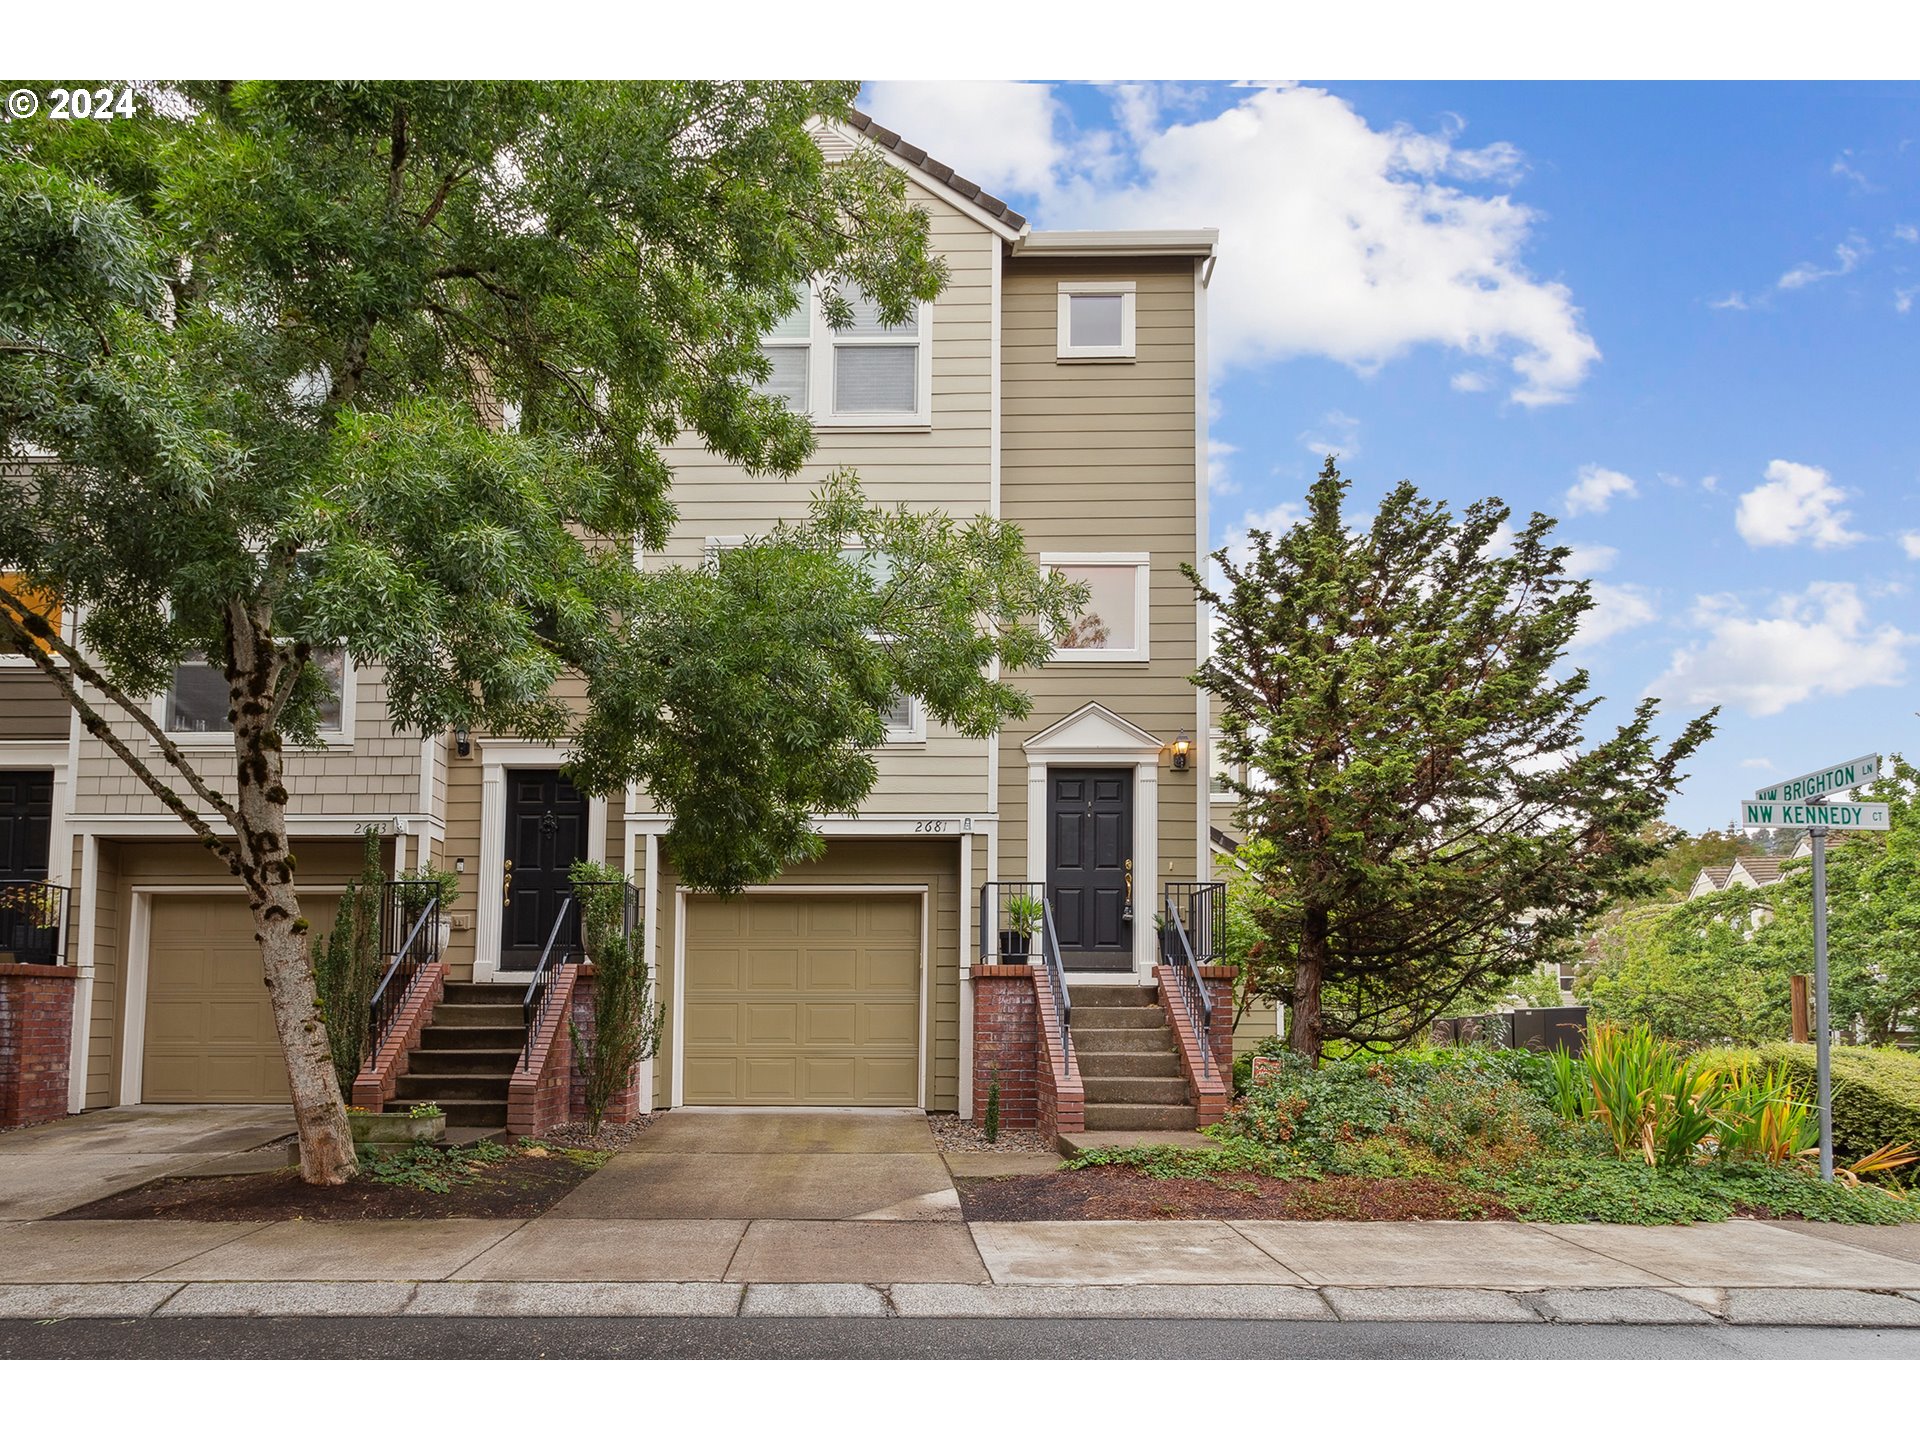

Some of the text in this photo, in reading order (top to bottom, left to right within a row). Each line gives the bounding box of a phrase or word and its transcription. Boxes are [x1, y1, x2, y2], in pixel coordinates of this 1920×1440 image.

[1783, 765, 1855, 801] BRIGHTON
[1862, 763, 1873, 776] LN
[1747, 805, 1883, 825] NW KENNEDY CT
[914, 820, 947, 832] 2681
